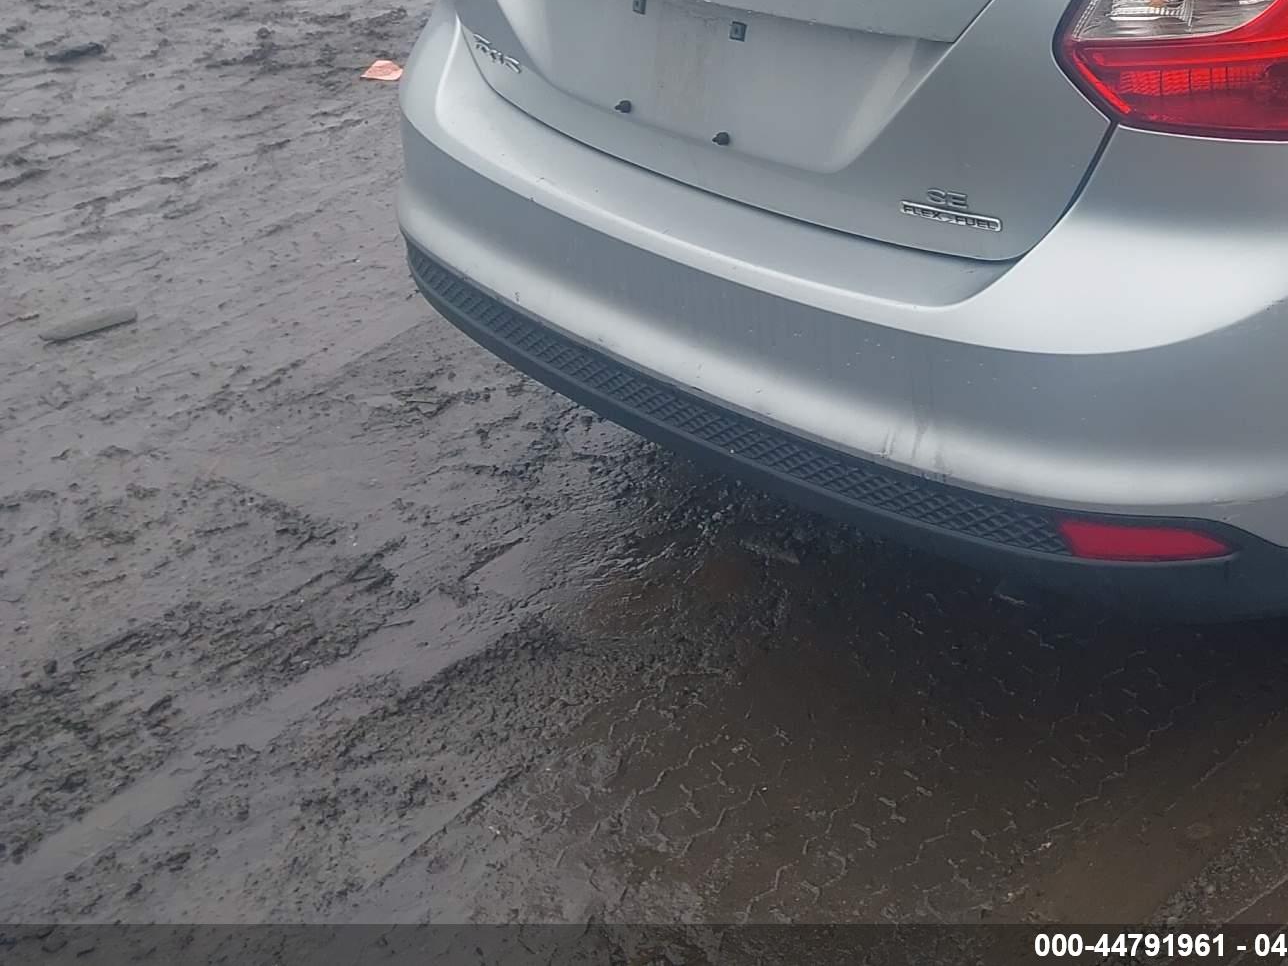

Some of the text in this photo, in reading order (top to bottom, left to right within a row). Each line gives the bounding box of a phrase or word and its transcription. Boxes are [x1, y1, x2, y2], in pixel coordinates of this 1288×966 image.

[927, 187, 968, 209] SE
[902, 204, 999, 231] FLEX FUEL
